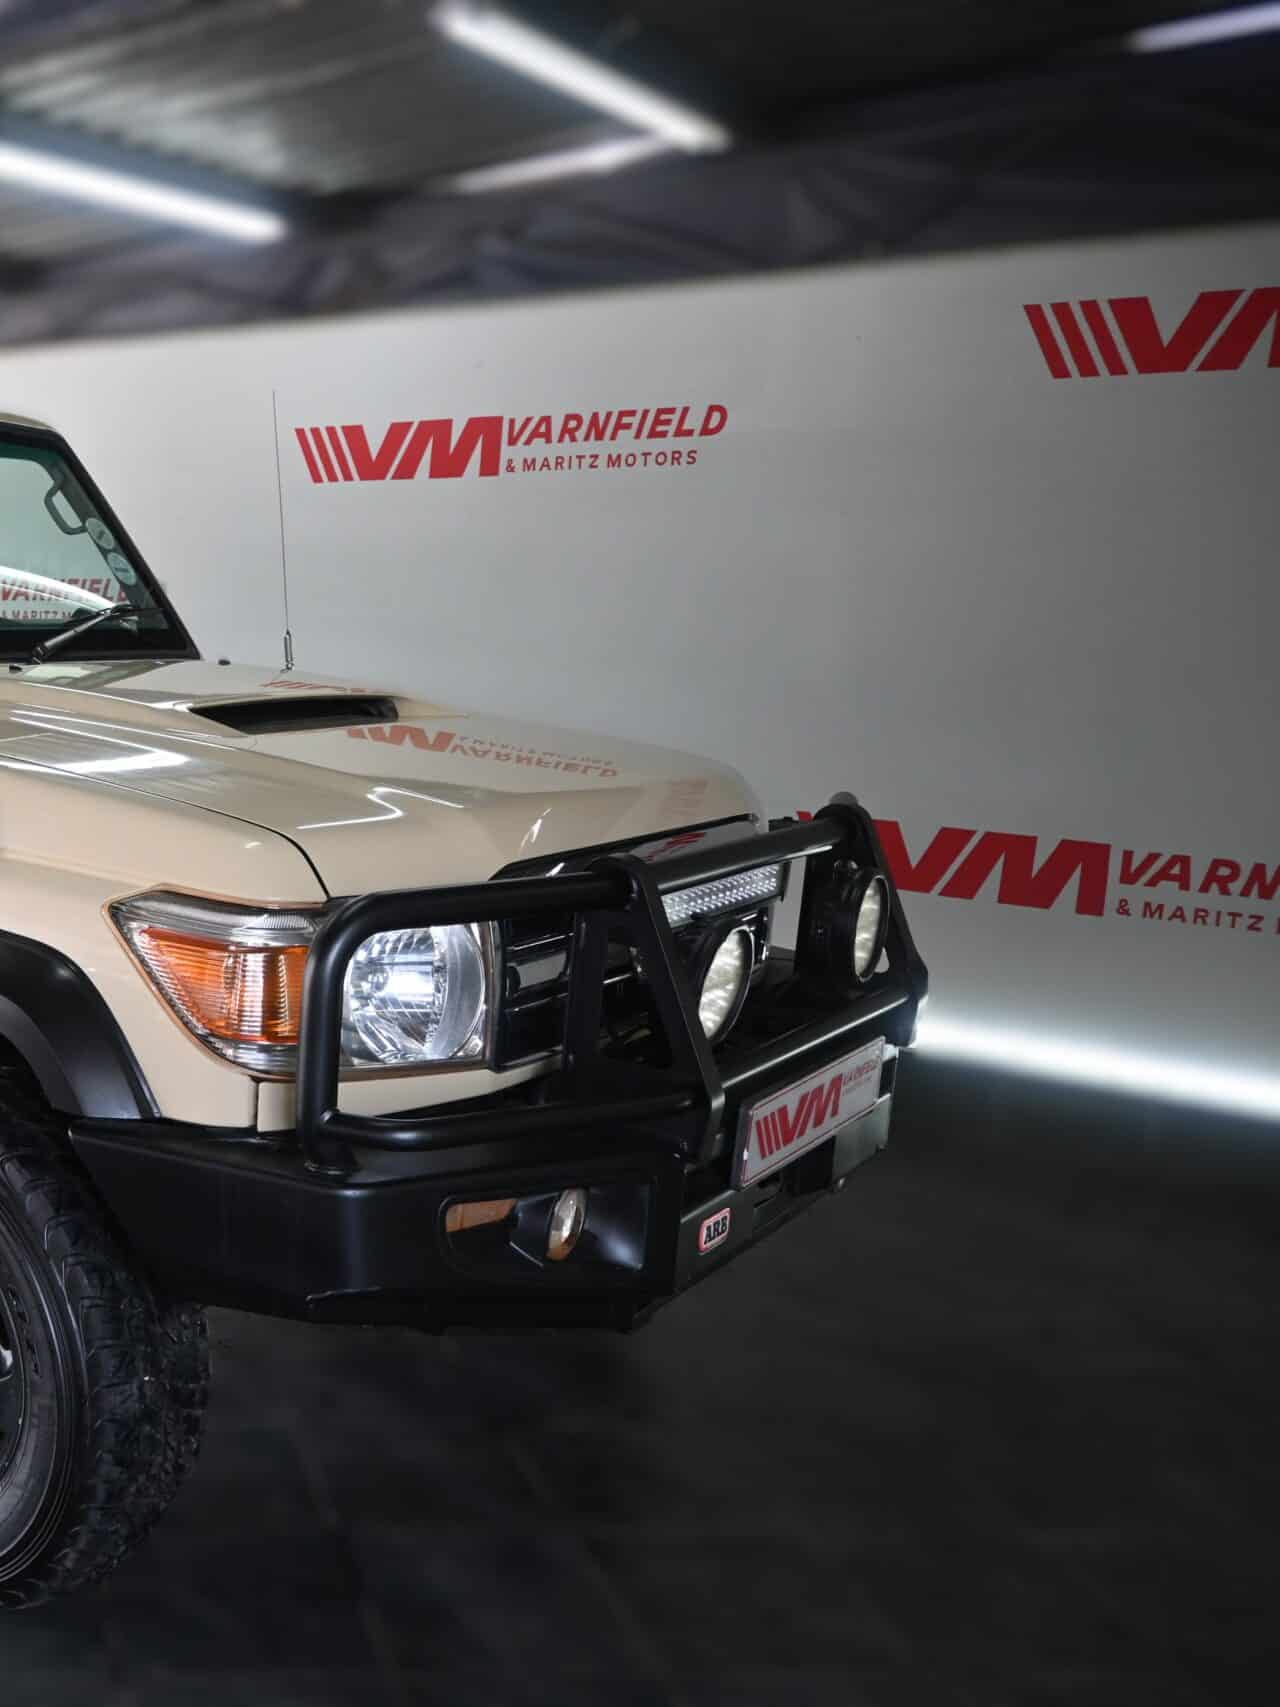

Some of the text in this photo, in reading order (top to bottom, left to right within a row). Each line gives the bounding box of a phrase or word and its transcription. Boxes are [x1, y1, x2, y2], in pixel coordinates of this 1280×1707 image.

[507, 404, 728, 446] VARNFIELD
[341, 416, 504, 481] VM
[505, 450, 698, 473] & MARITZ MOTORS
[871, 818, 1112, 917] VM
[1116, 898, 1131, 916] &
[1142, 901, 1265, 932] MARITZ
[777, 1073, 843, 1146] VM
[702, 1212, 729, 1247] ARB
